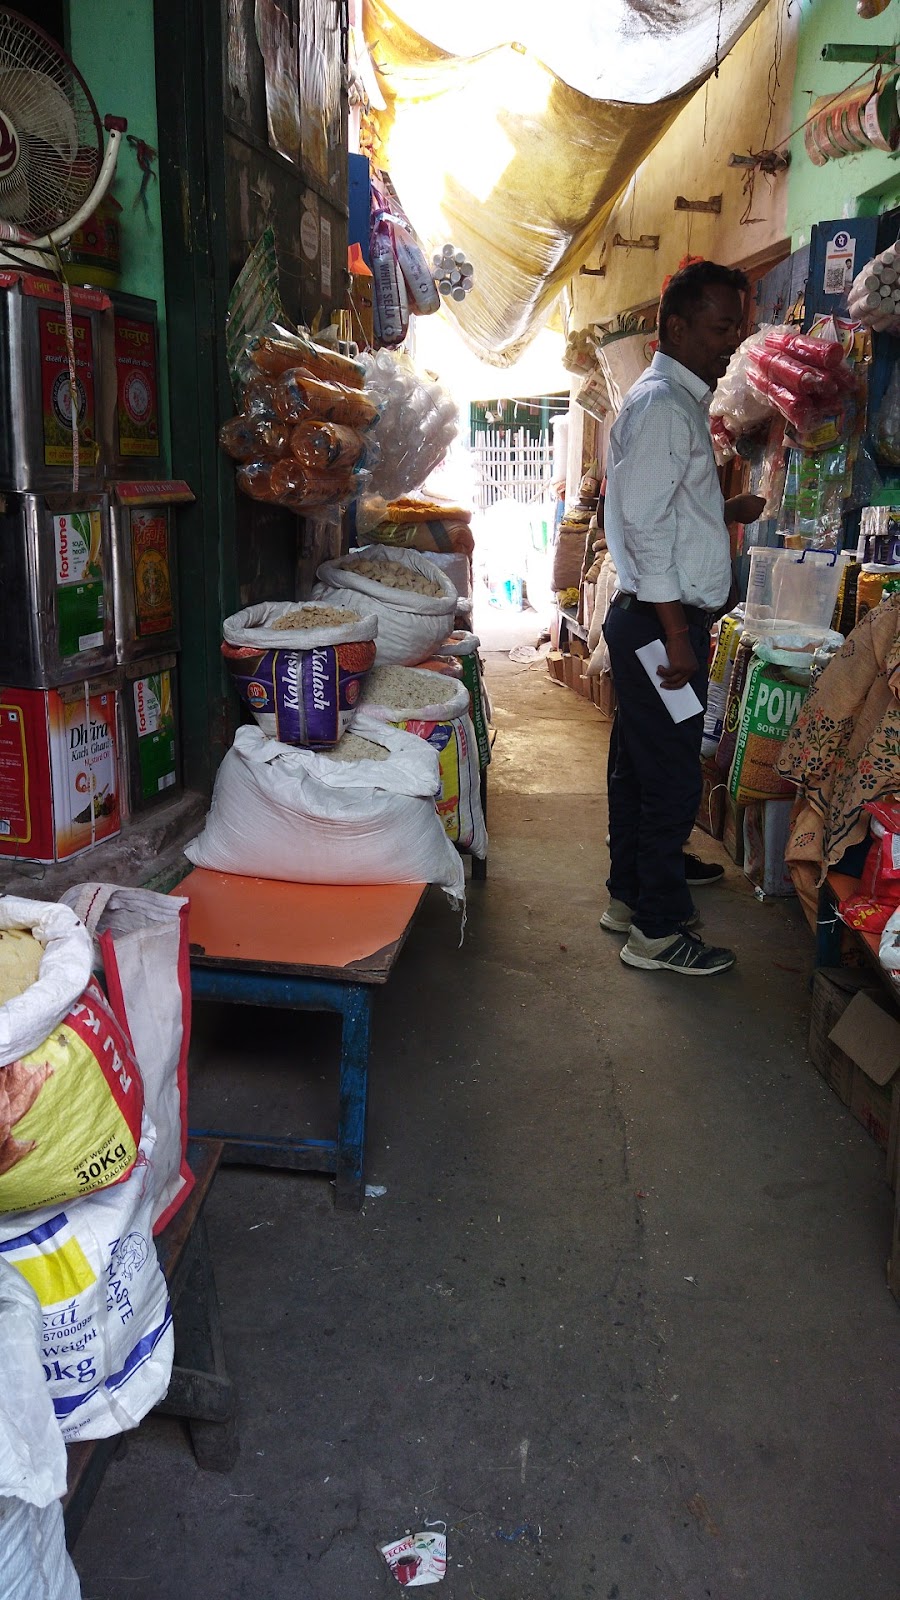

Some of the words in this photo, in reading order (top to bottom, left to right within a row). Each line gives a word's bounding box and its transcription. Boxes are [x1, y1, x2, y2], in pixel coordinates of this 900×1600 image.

[380, 263, 392, 291] WHITE
[383, 294, 395, 320] SELLA
[46, 321, 86, 340] धनष
[59, 516, 69, 579] fortune
[312, 649, 330, 711] Kalash
[749, 660, 765, 684] EXED
[137, 681, 147, 733] fortune
[754, 683, 806, 727] POW
[740, 706, 753, 750] POWER
[757, 722, 790, 738] SORTE
[71, 745, 91, 762] Kach
[84, 754, 103, 768] Mstard
[479, 734, 491, 770] WER
[730, 747, 745, 793] SORTEXED
[69, 1002, 101, 1036] KA
[103, 1035, 133, 1095] RAJ
[73, 1158, 89, 1173] NET
[90, 1133, 118, 1161] WEIGHT
[76, 1142, 128, 1187] 30Kg
[77, 1178, 104, 1195] WHEN
[104, 1155, 133, 1182] PACKED
[105, 1236, 135, 1325] NMASTE
[42, 1327, 98, 1357] Weight
[43, 1315, 93, 1342] 57000099
[386, 1540, 413, 1560] ECAFÉ
